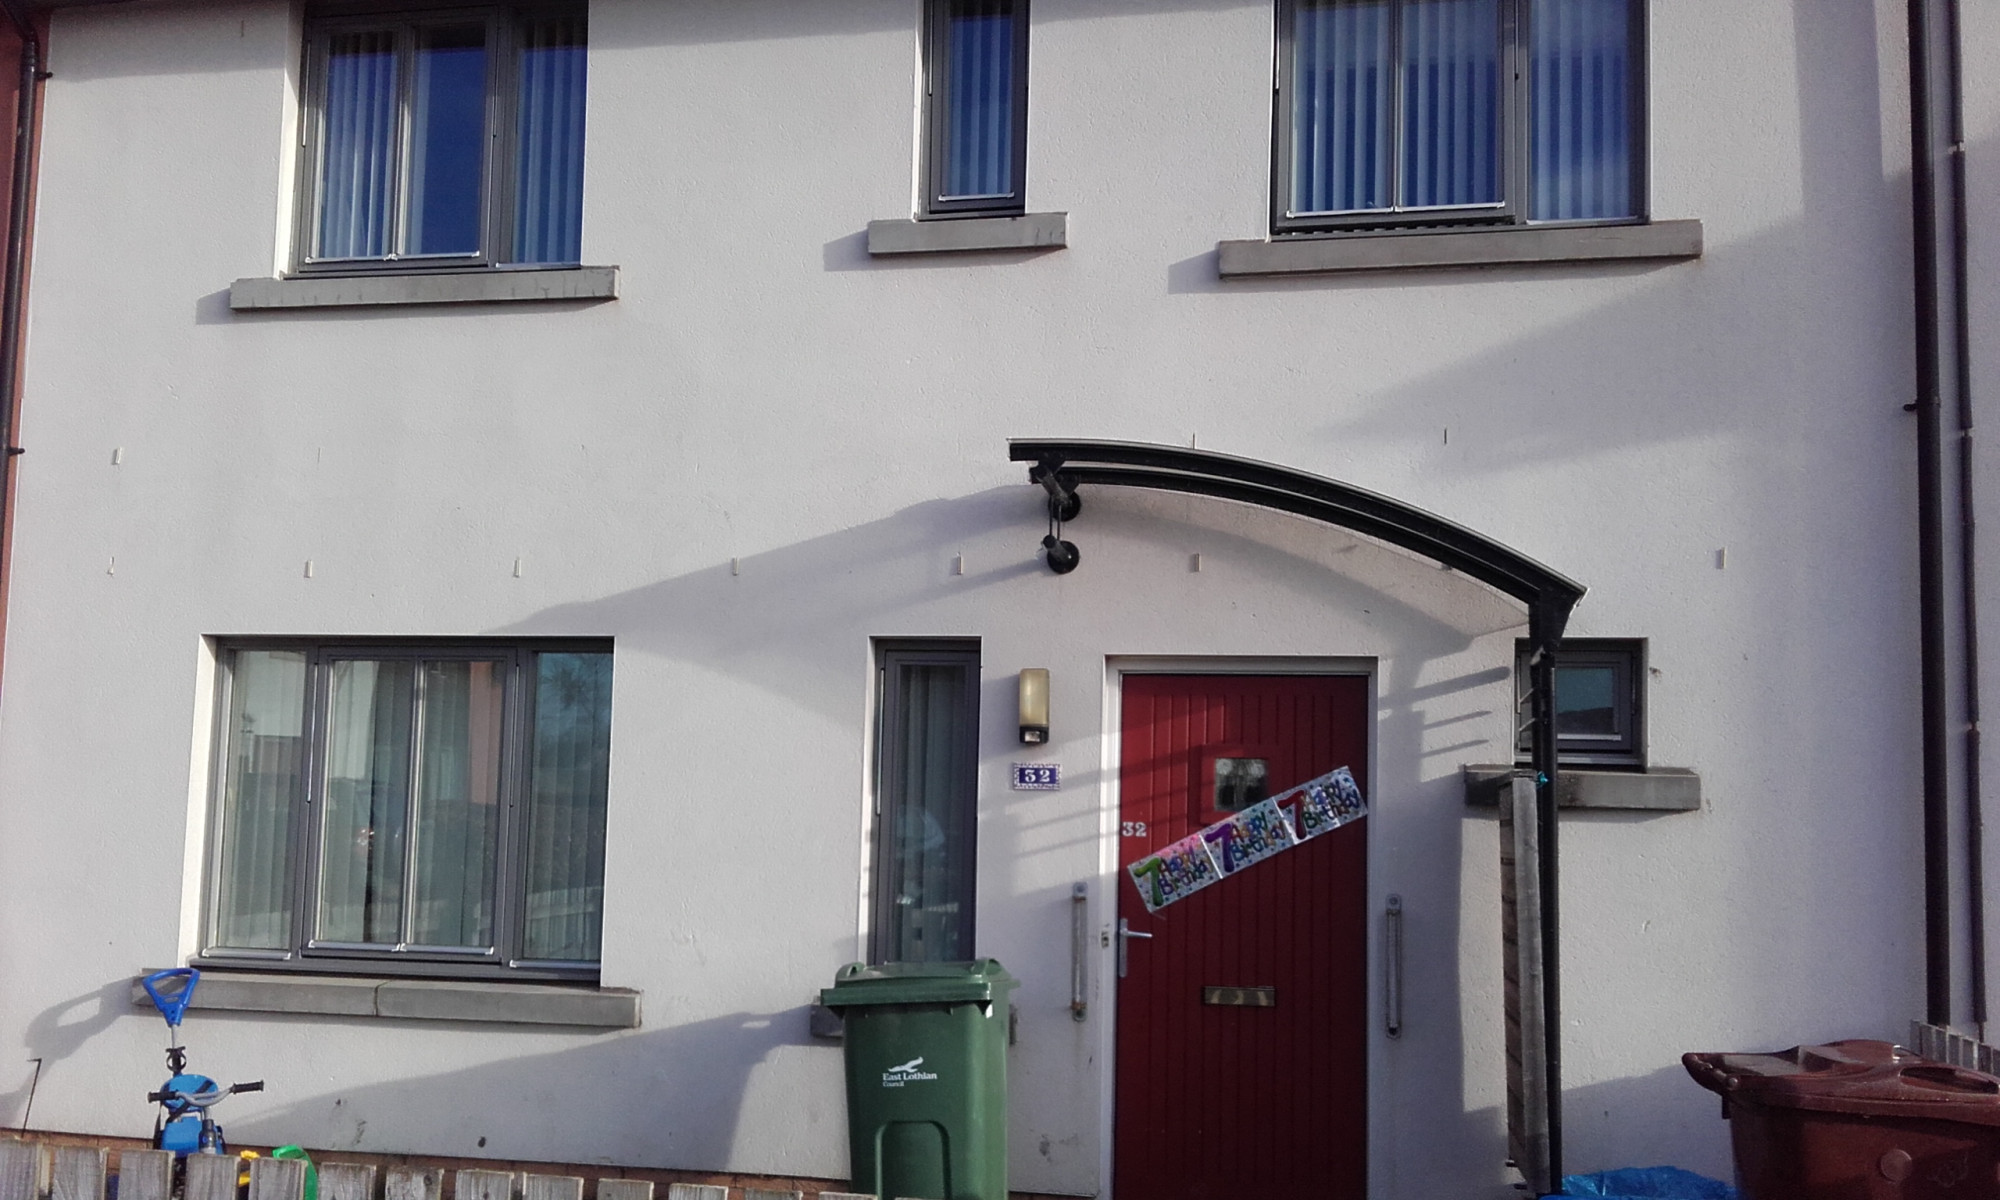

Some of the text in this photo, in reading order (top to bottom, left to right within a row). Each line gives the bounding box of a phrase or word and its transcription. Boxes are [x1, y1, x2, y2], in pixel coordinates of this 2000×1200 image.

[1024, 769, 1051, 783] 32
[1122, 821, 1147, 837] 32
[1278, 789, 1307, 839] 7
[1205, 823, 1234, 872] 7
[1134, 857, 1163, 906] 7
[882, 1072, 938, 1080] East Lothian
